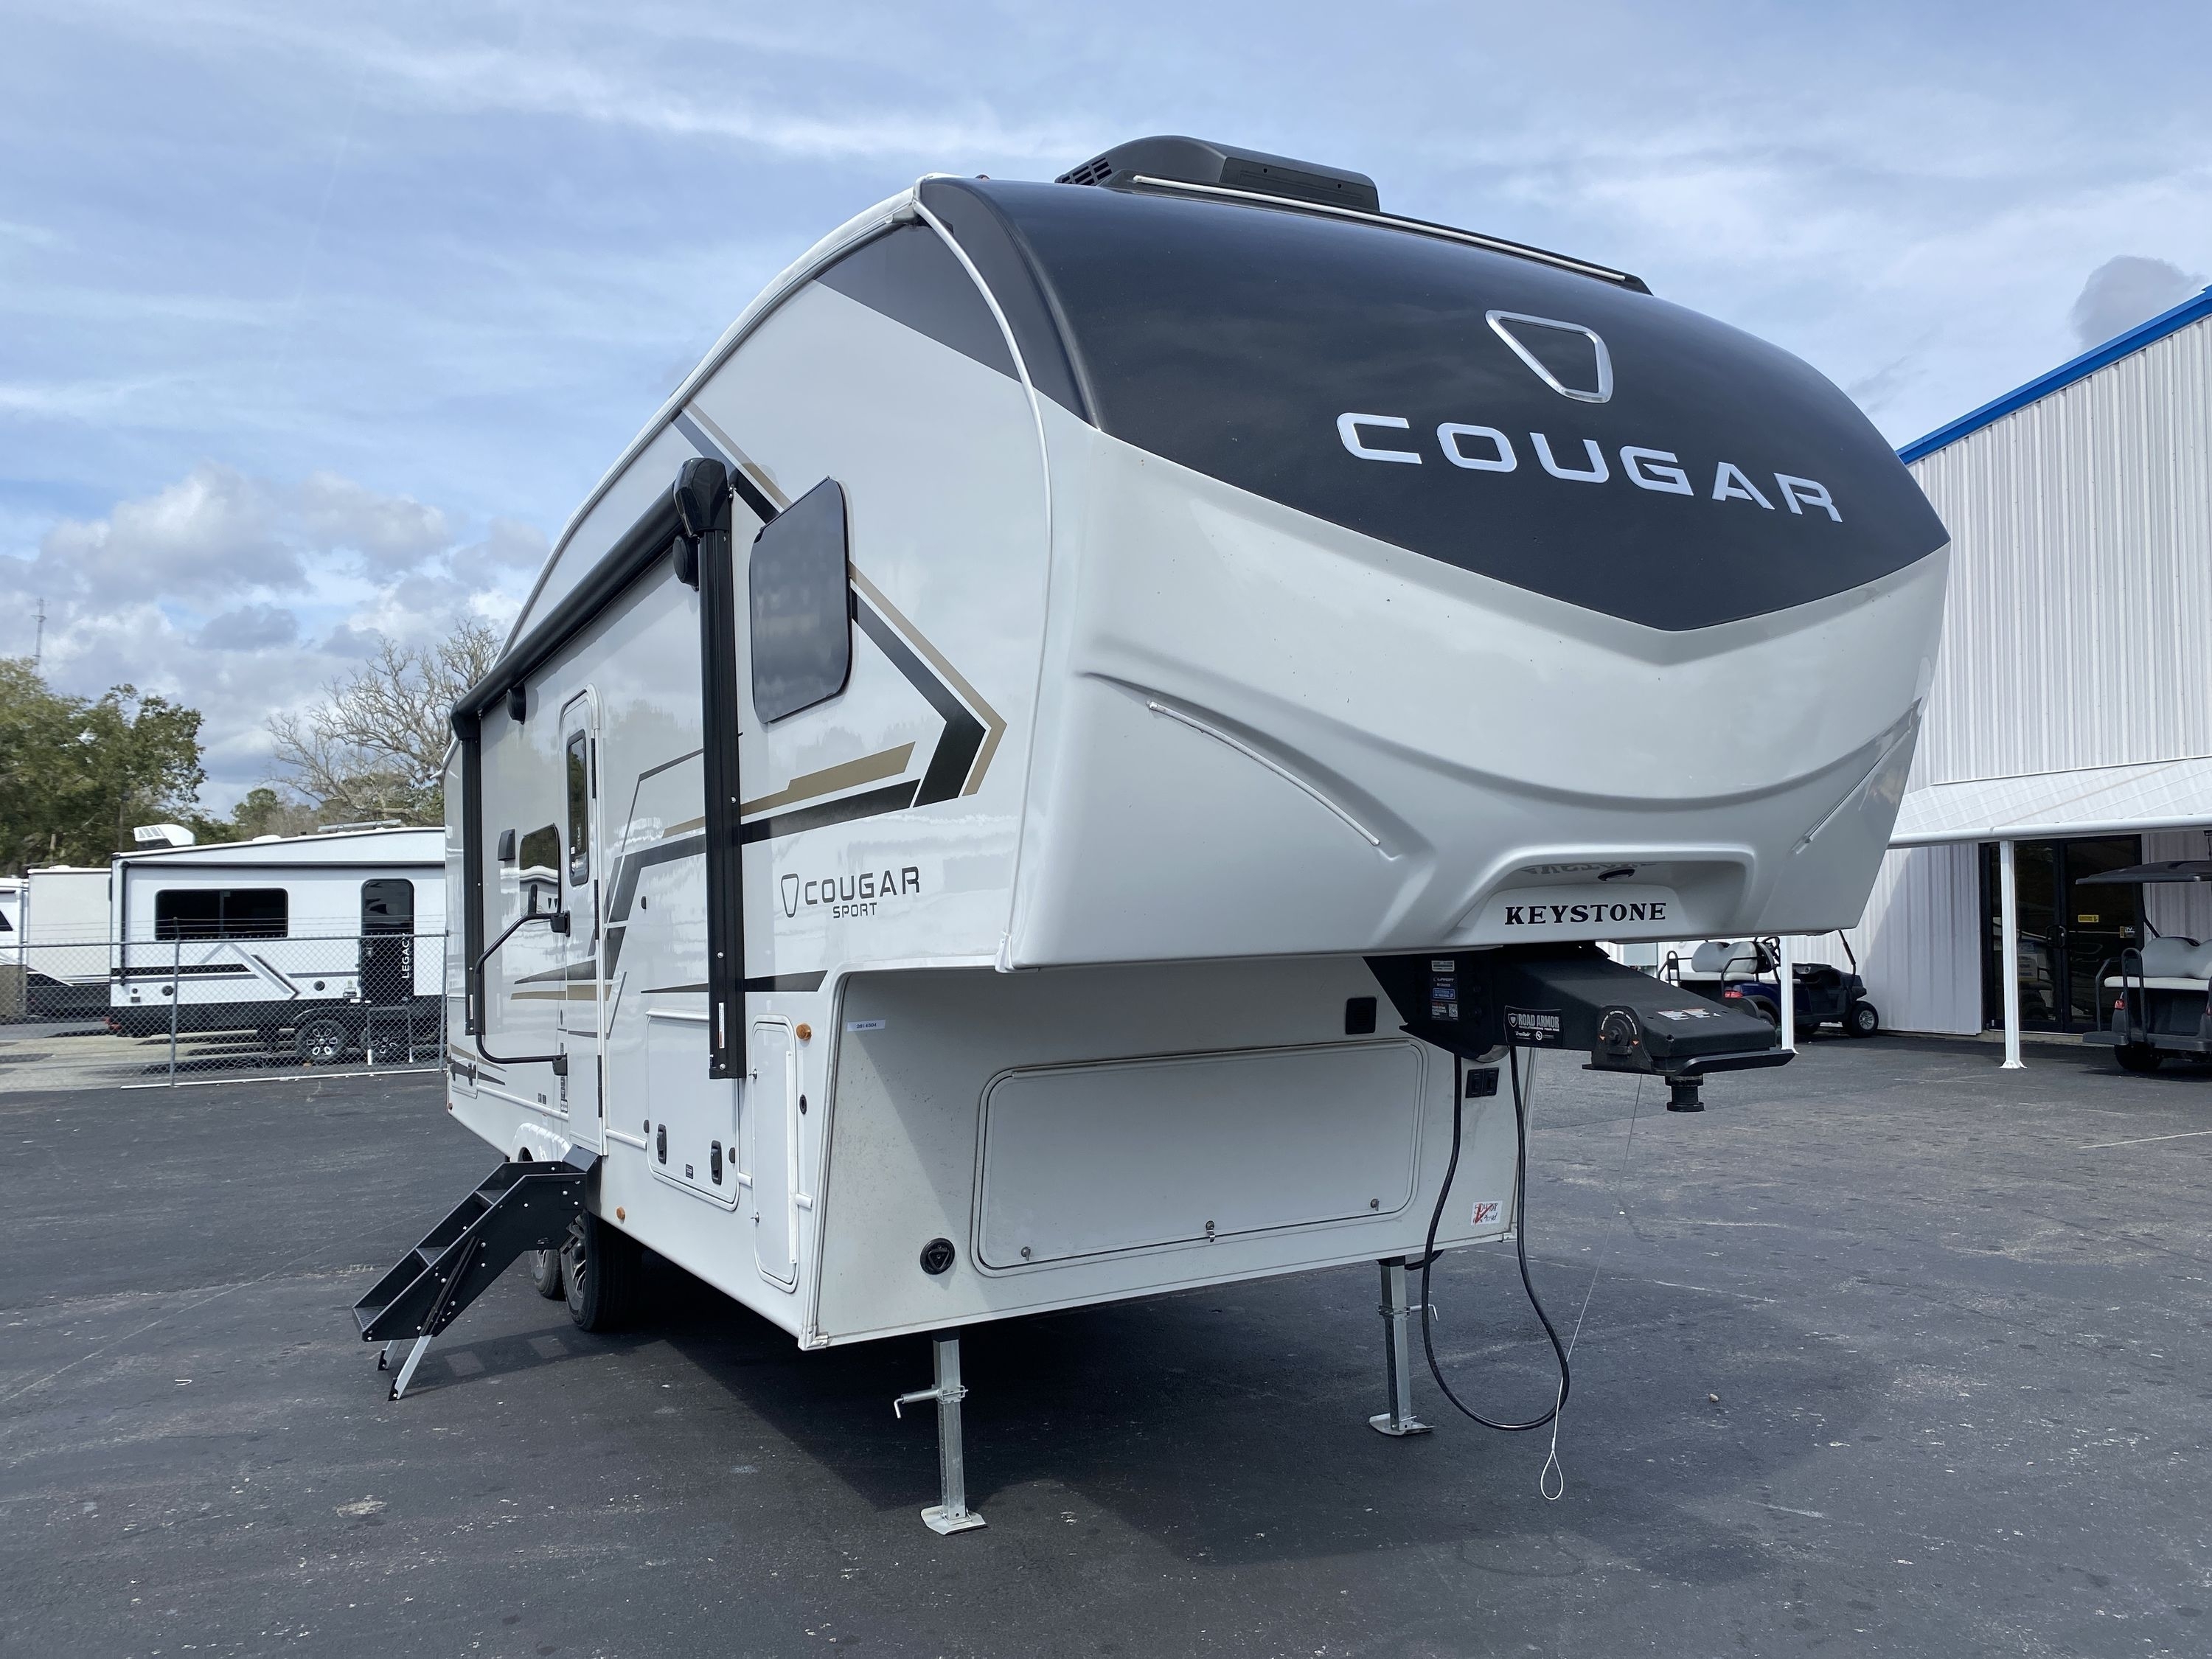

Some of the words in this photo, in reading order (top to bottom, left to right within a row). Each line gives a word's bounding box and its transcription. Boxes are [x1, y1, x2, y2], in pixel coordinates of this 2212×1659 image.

[1336, 412, 1843, 523] COUGAR
[804, 866, 920, 905] COUGAR
[833, 902, 877, 919] SPORT
[1504, 902, 1666, 925] KEYSTONE
[1518, 1013, 1536, 1026] ROAD
[1536, 1015, 1559, 1029] ARMOR
